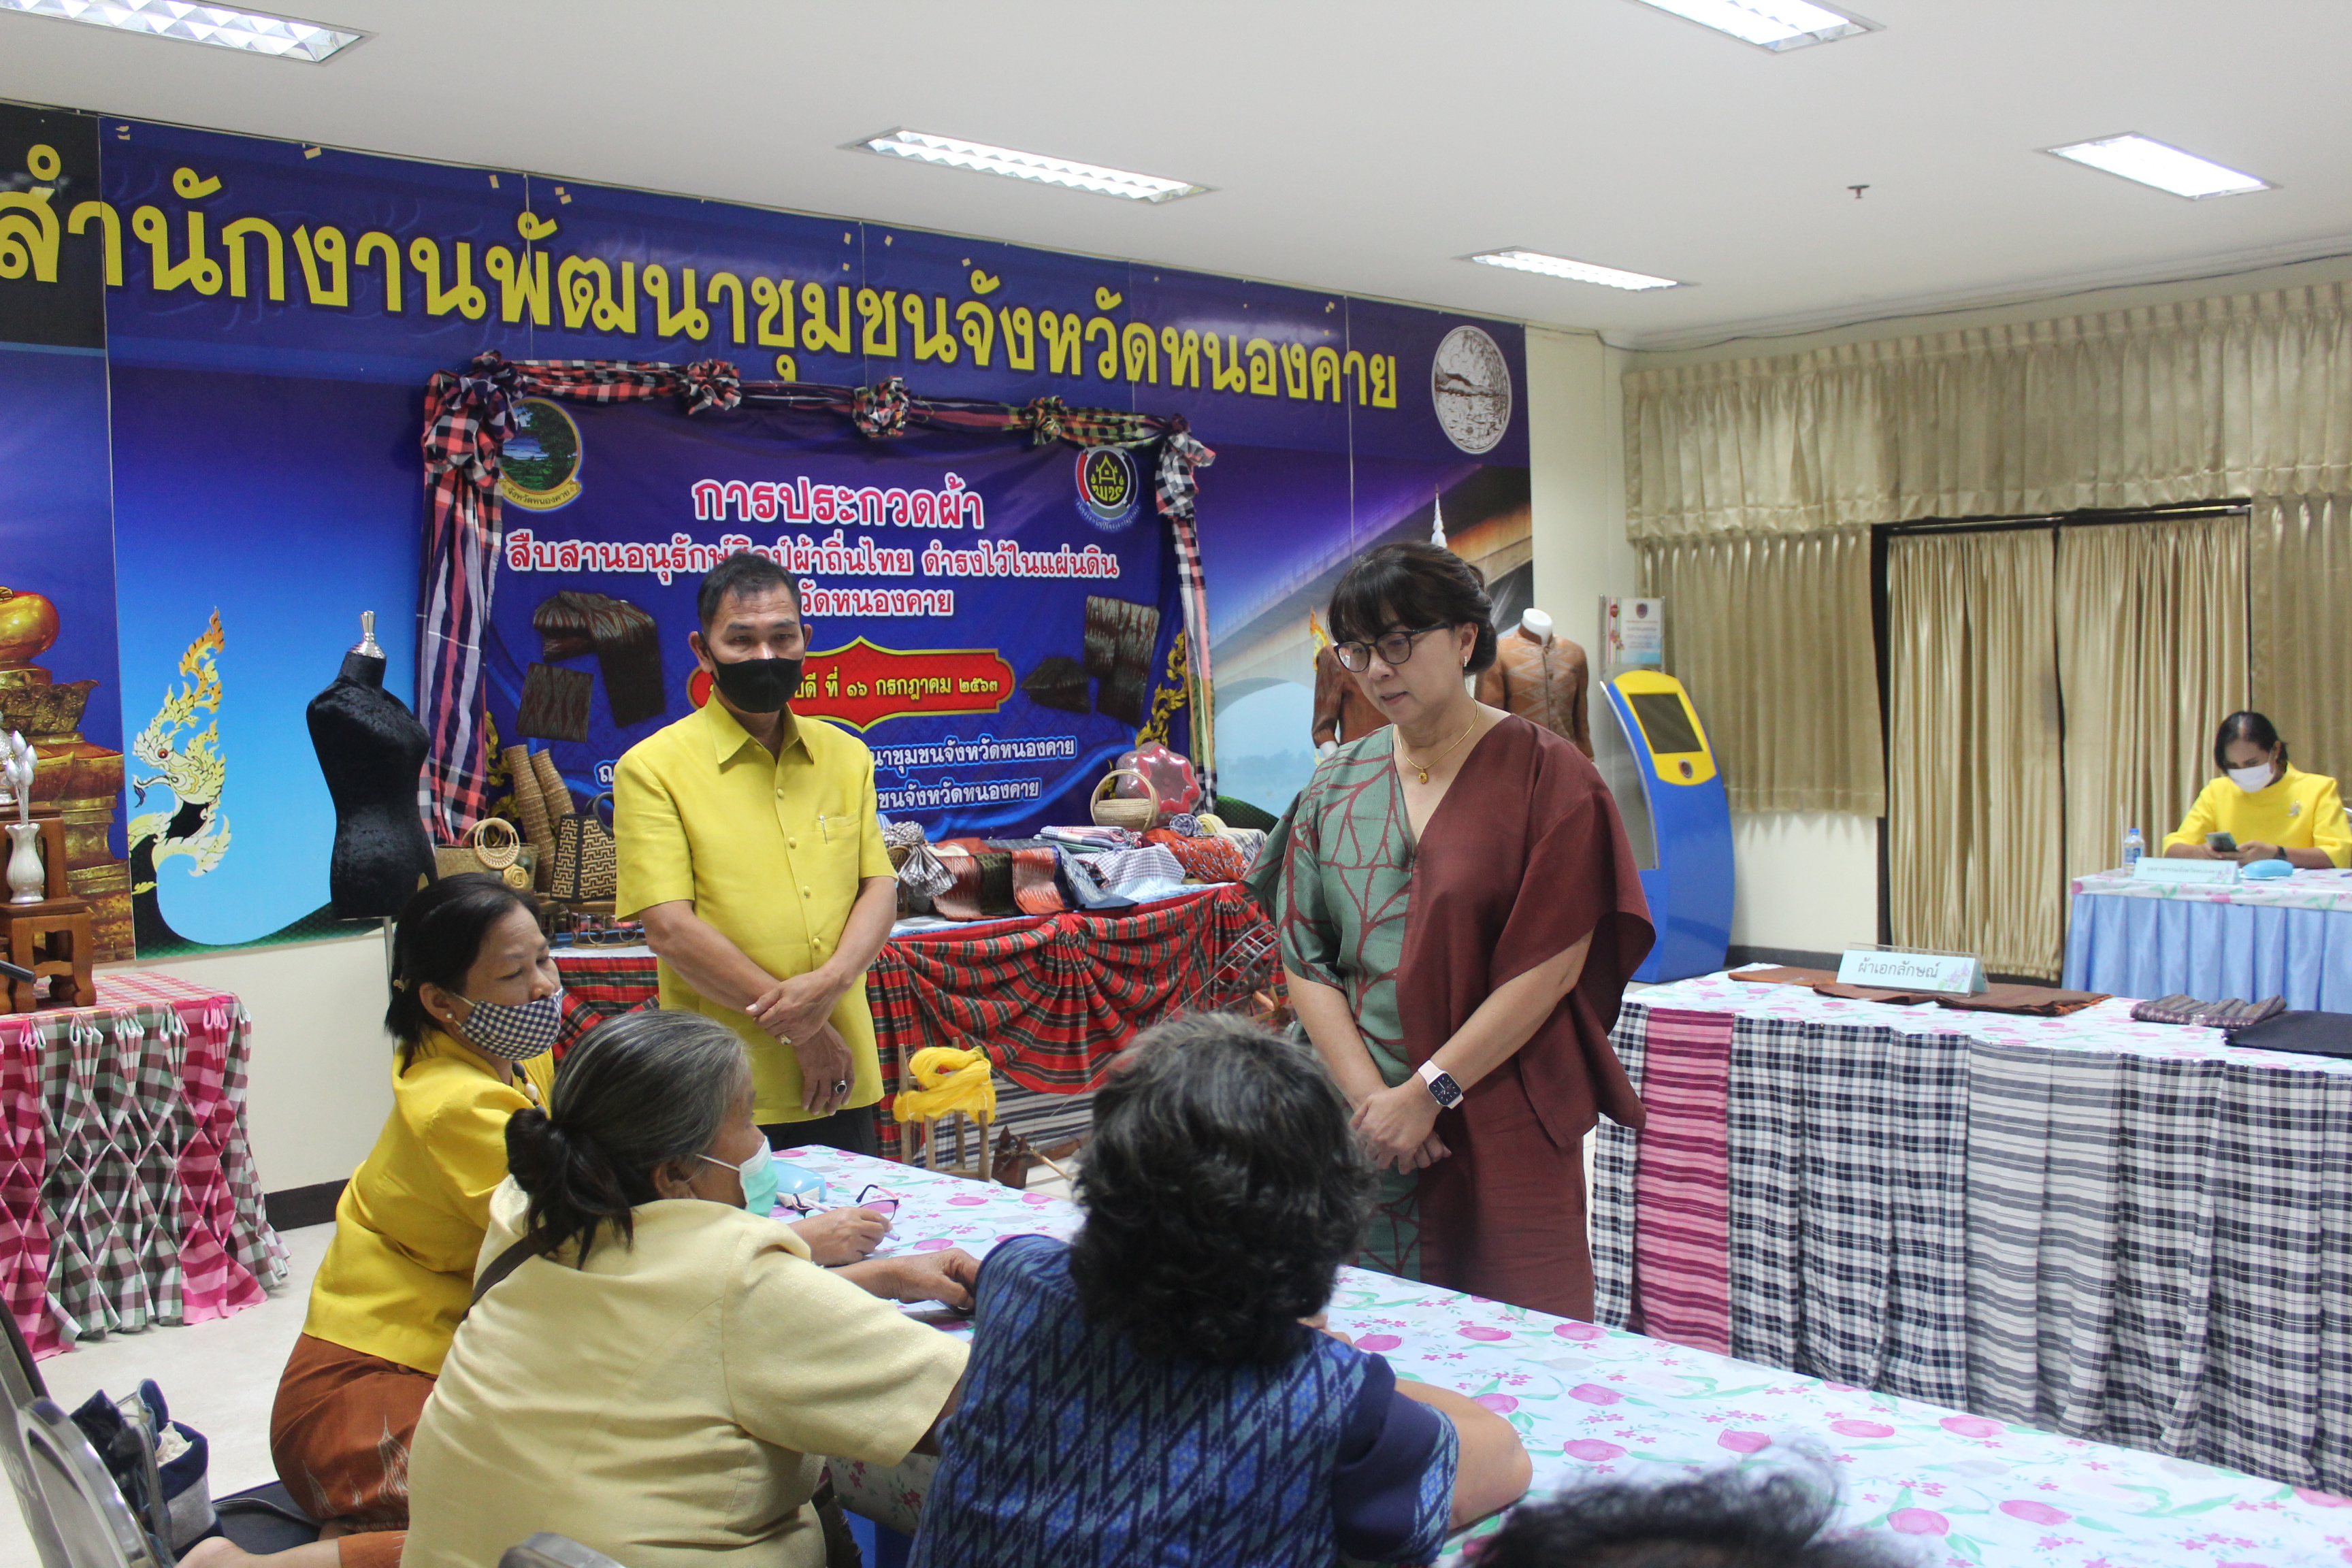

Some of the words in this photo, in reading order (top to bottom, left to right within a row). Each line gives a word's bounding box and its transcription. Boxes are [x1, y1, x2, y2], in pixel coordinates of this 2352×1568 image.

[0, 144, 1397, 409] สำนักงานพัฒนาชุมชนจังหวัดหนองคาย
[508, 487, 570, 505] จังหวัดหนองคาย
[693, 474, 984, 529] การประกวดผ้า
[924, 541, 1119, 577] ดำรงไว้ในแผ่นดิน
[825, 666, 838, 697] ที่
[847, 681, 868, 697] ๑๖
[875, 676, 951, 700] กรกฎาคม
[959, 677, 998, 693] ๒๕๖๓
[1857, 957, 1941, 979] ผ้าเอกลักษณ์
